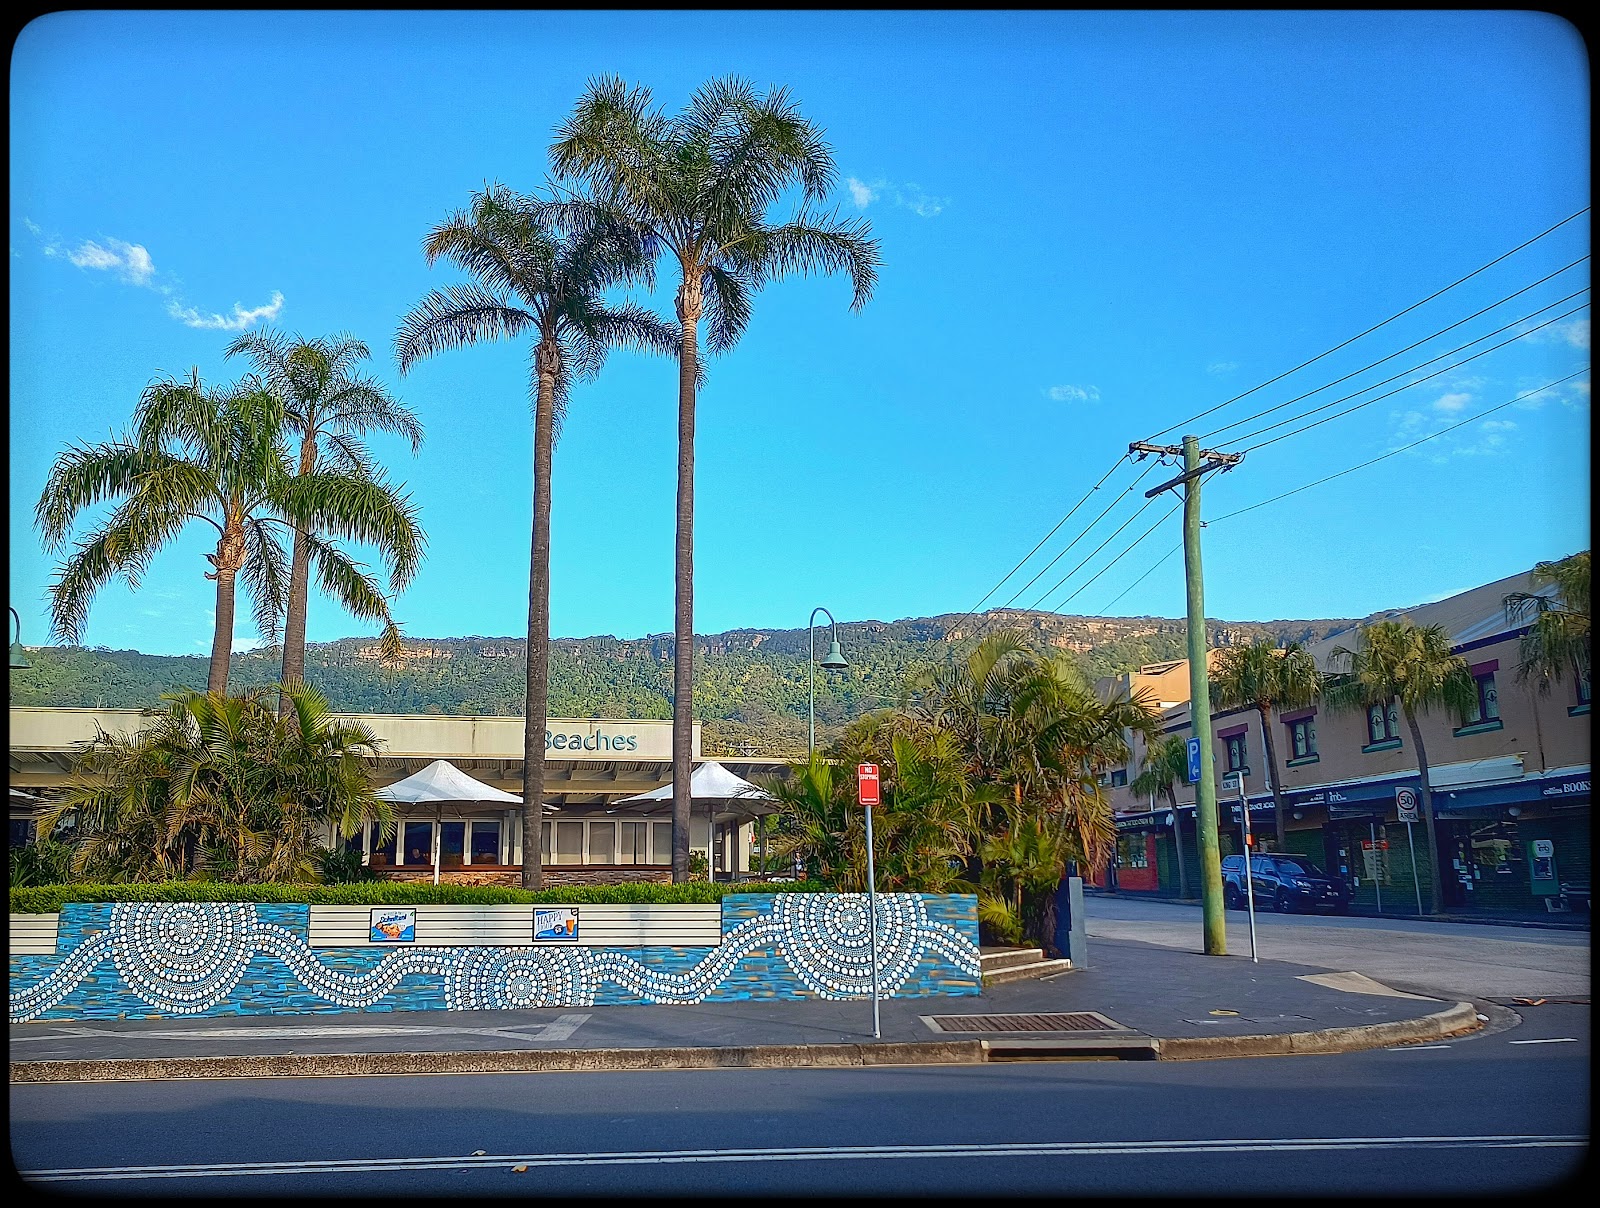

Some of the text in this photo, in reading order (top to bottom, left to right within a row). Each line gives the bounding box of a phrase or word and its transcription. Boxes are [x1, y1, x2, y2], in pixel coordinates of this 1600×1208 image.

[1189, 742, 1198, 762] P
[864, 766, 873, 774] NO
[1222, 781, 1231, 789] KING
[1400, 795, 1413, 805] 50
[1400, 812, 1418, 820] AREA
[537, 911, 562, 924] HAPPY
